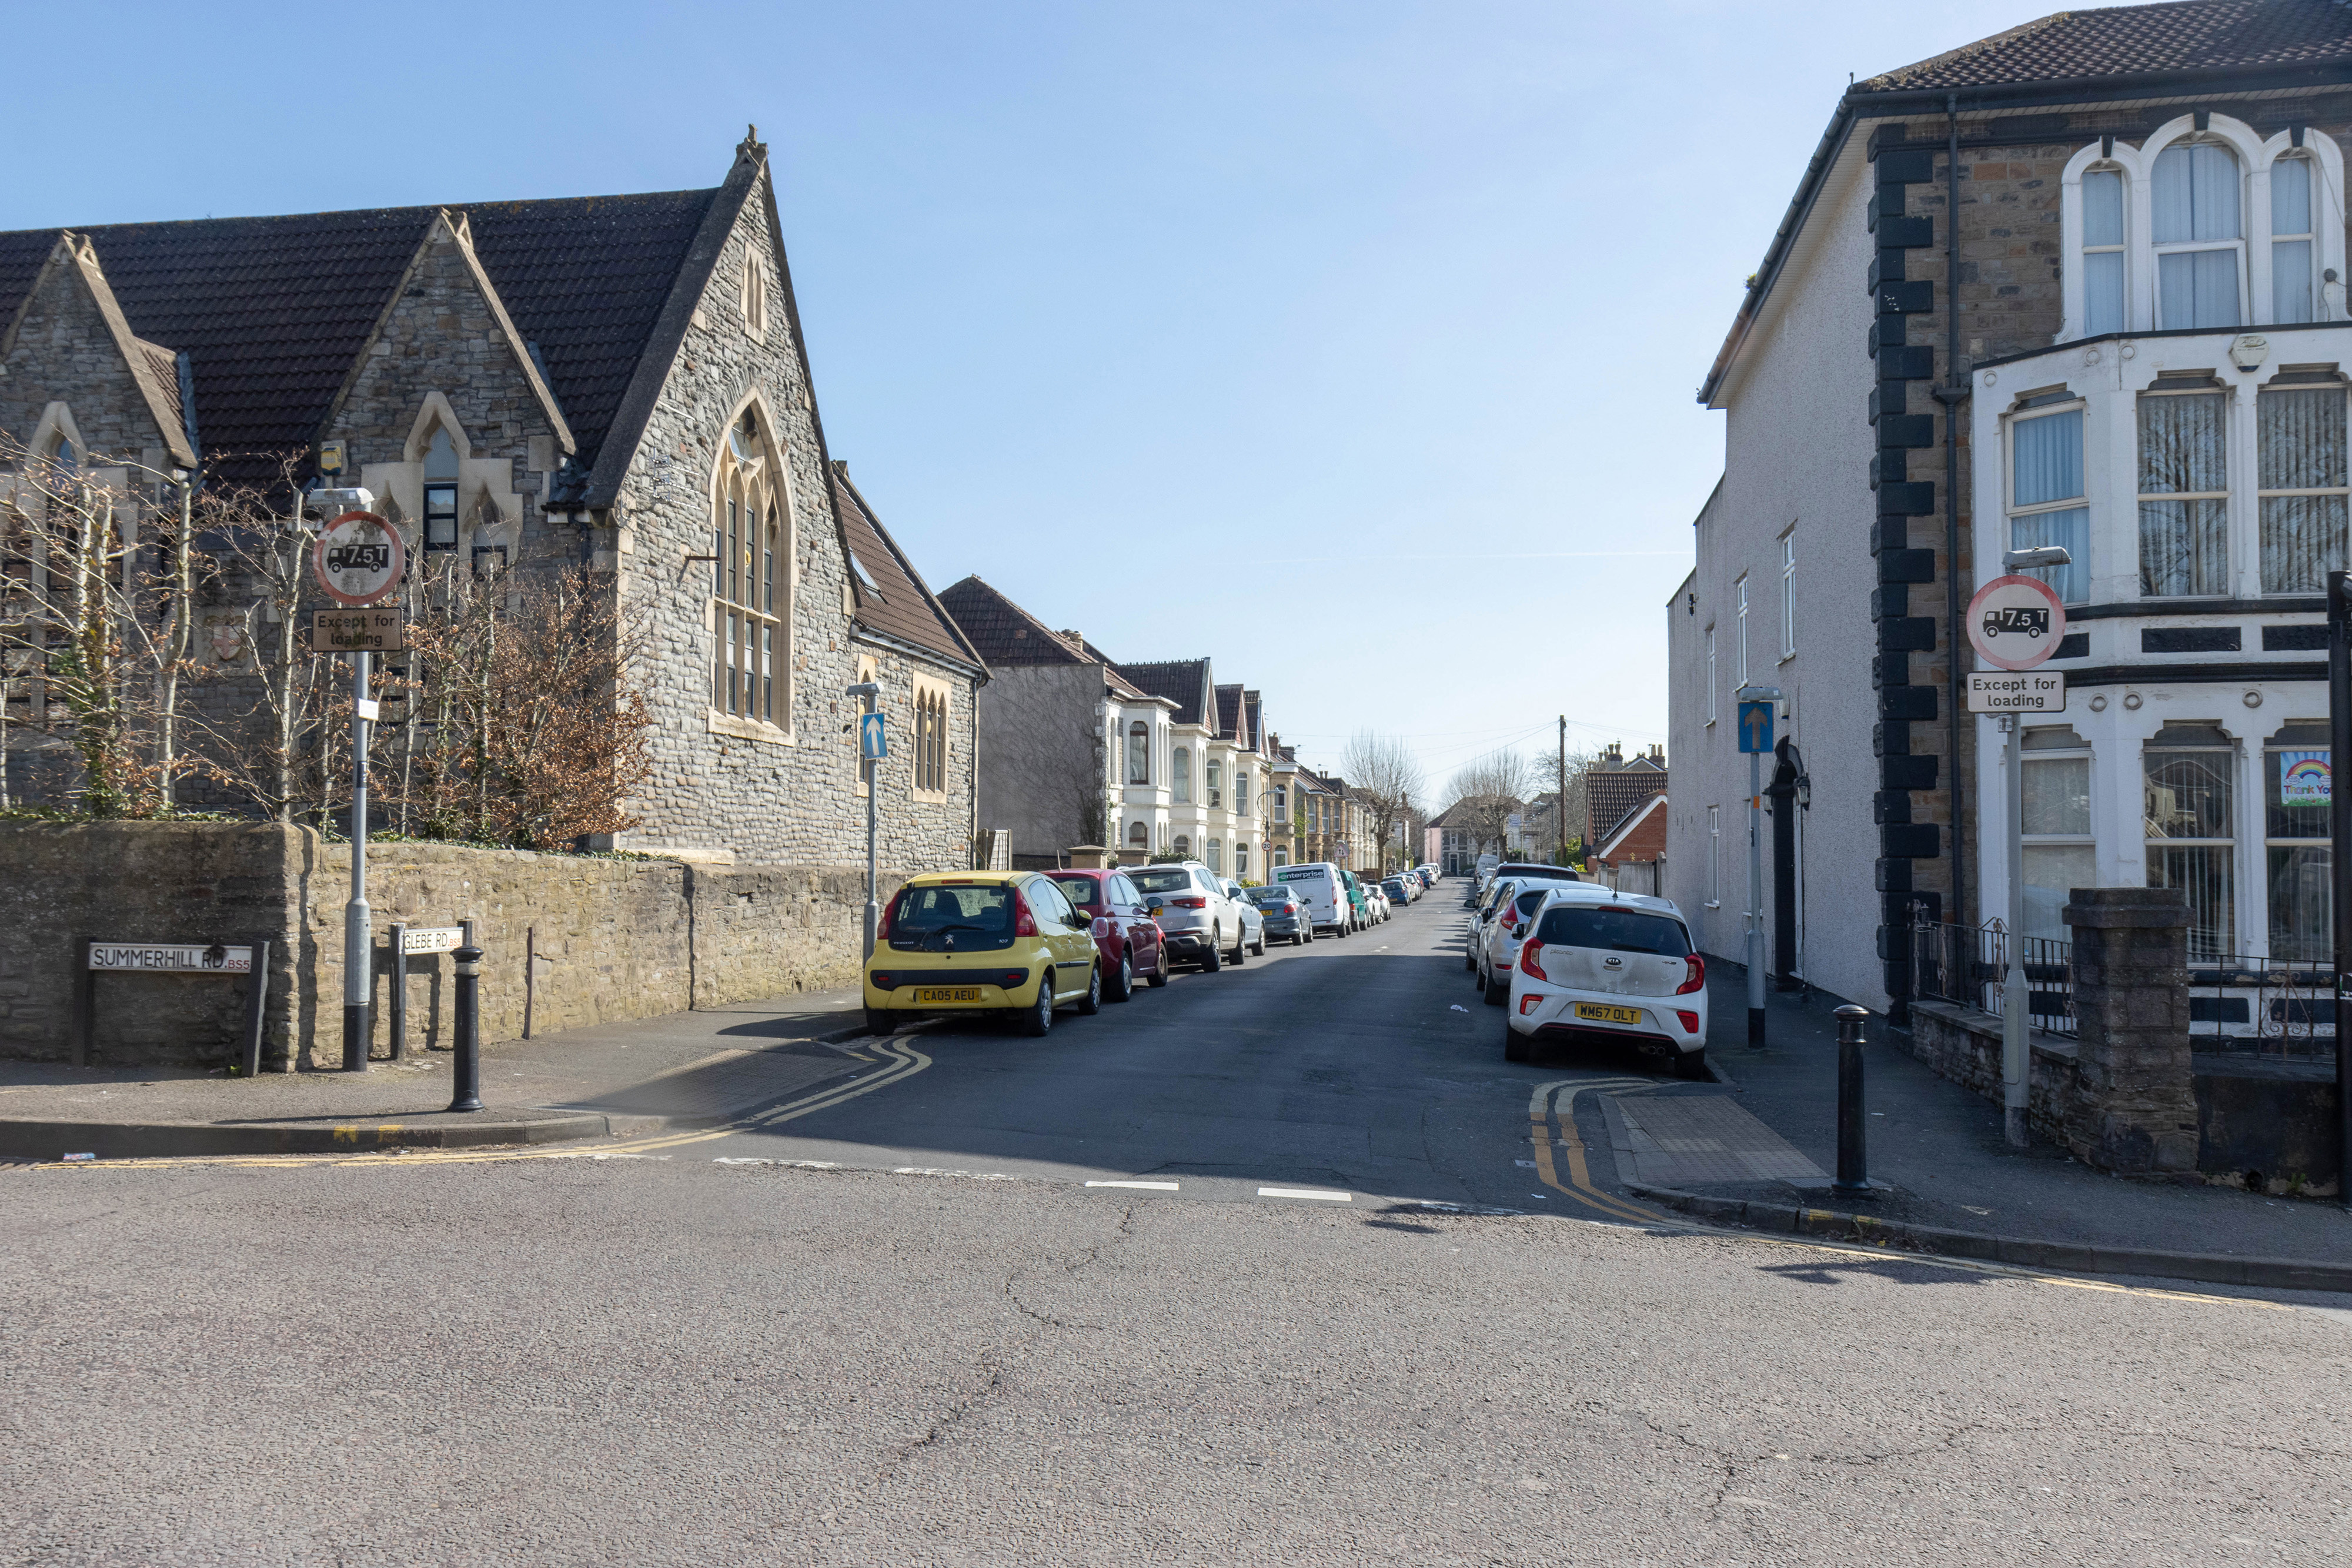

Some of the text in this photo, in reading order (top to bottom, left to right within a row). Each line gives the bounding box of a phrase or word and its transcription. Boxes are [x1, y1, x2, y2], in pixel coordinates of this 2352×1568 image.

[318, 614, 395, 629] Except for
[331, 633, 382, 647] loading
[1973, 678, 2056, 692] Except for
[1988, 694, 2044, 708] loading
[2284, 785, 2314, 794] Thank
[1279, 871, 1324, 880] enterprise
[405, 934, 432, 949] GLEBE
[449, 938, 461, 947] BS5
[94, 949, 196, 967] SUMMERHILL
[228, 959, 250, 969] BS5
[924, 991, 974, 1001] CA05 AEU
[1580, 1005, 1636, 1021] WM67 OLT
